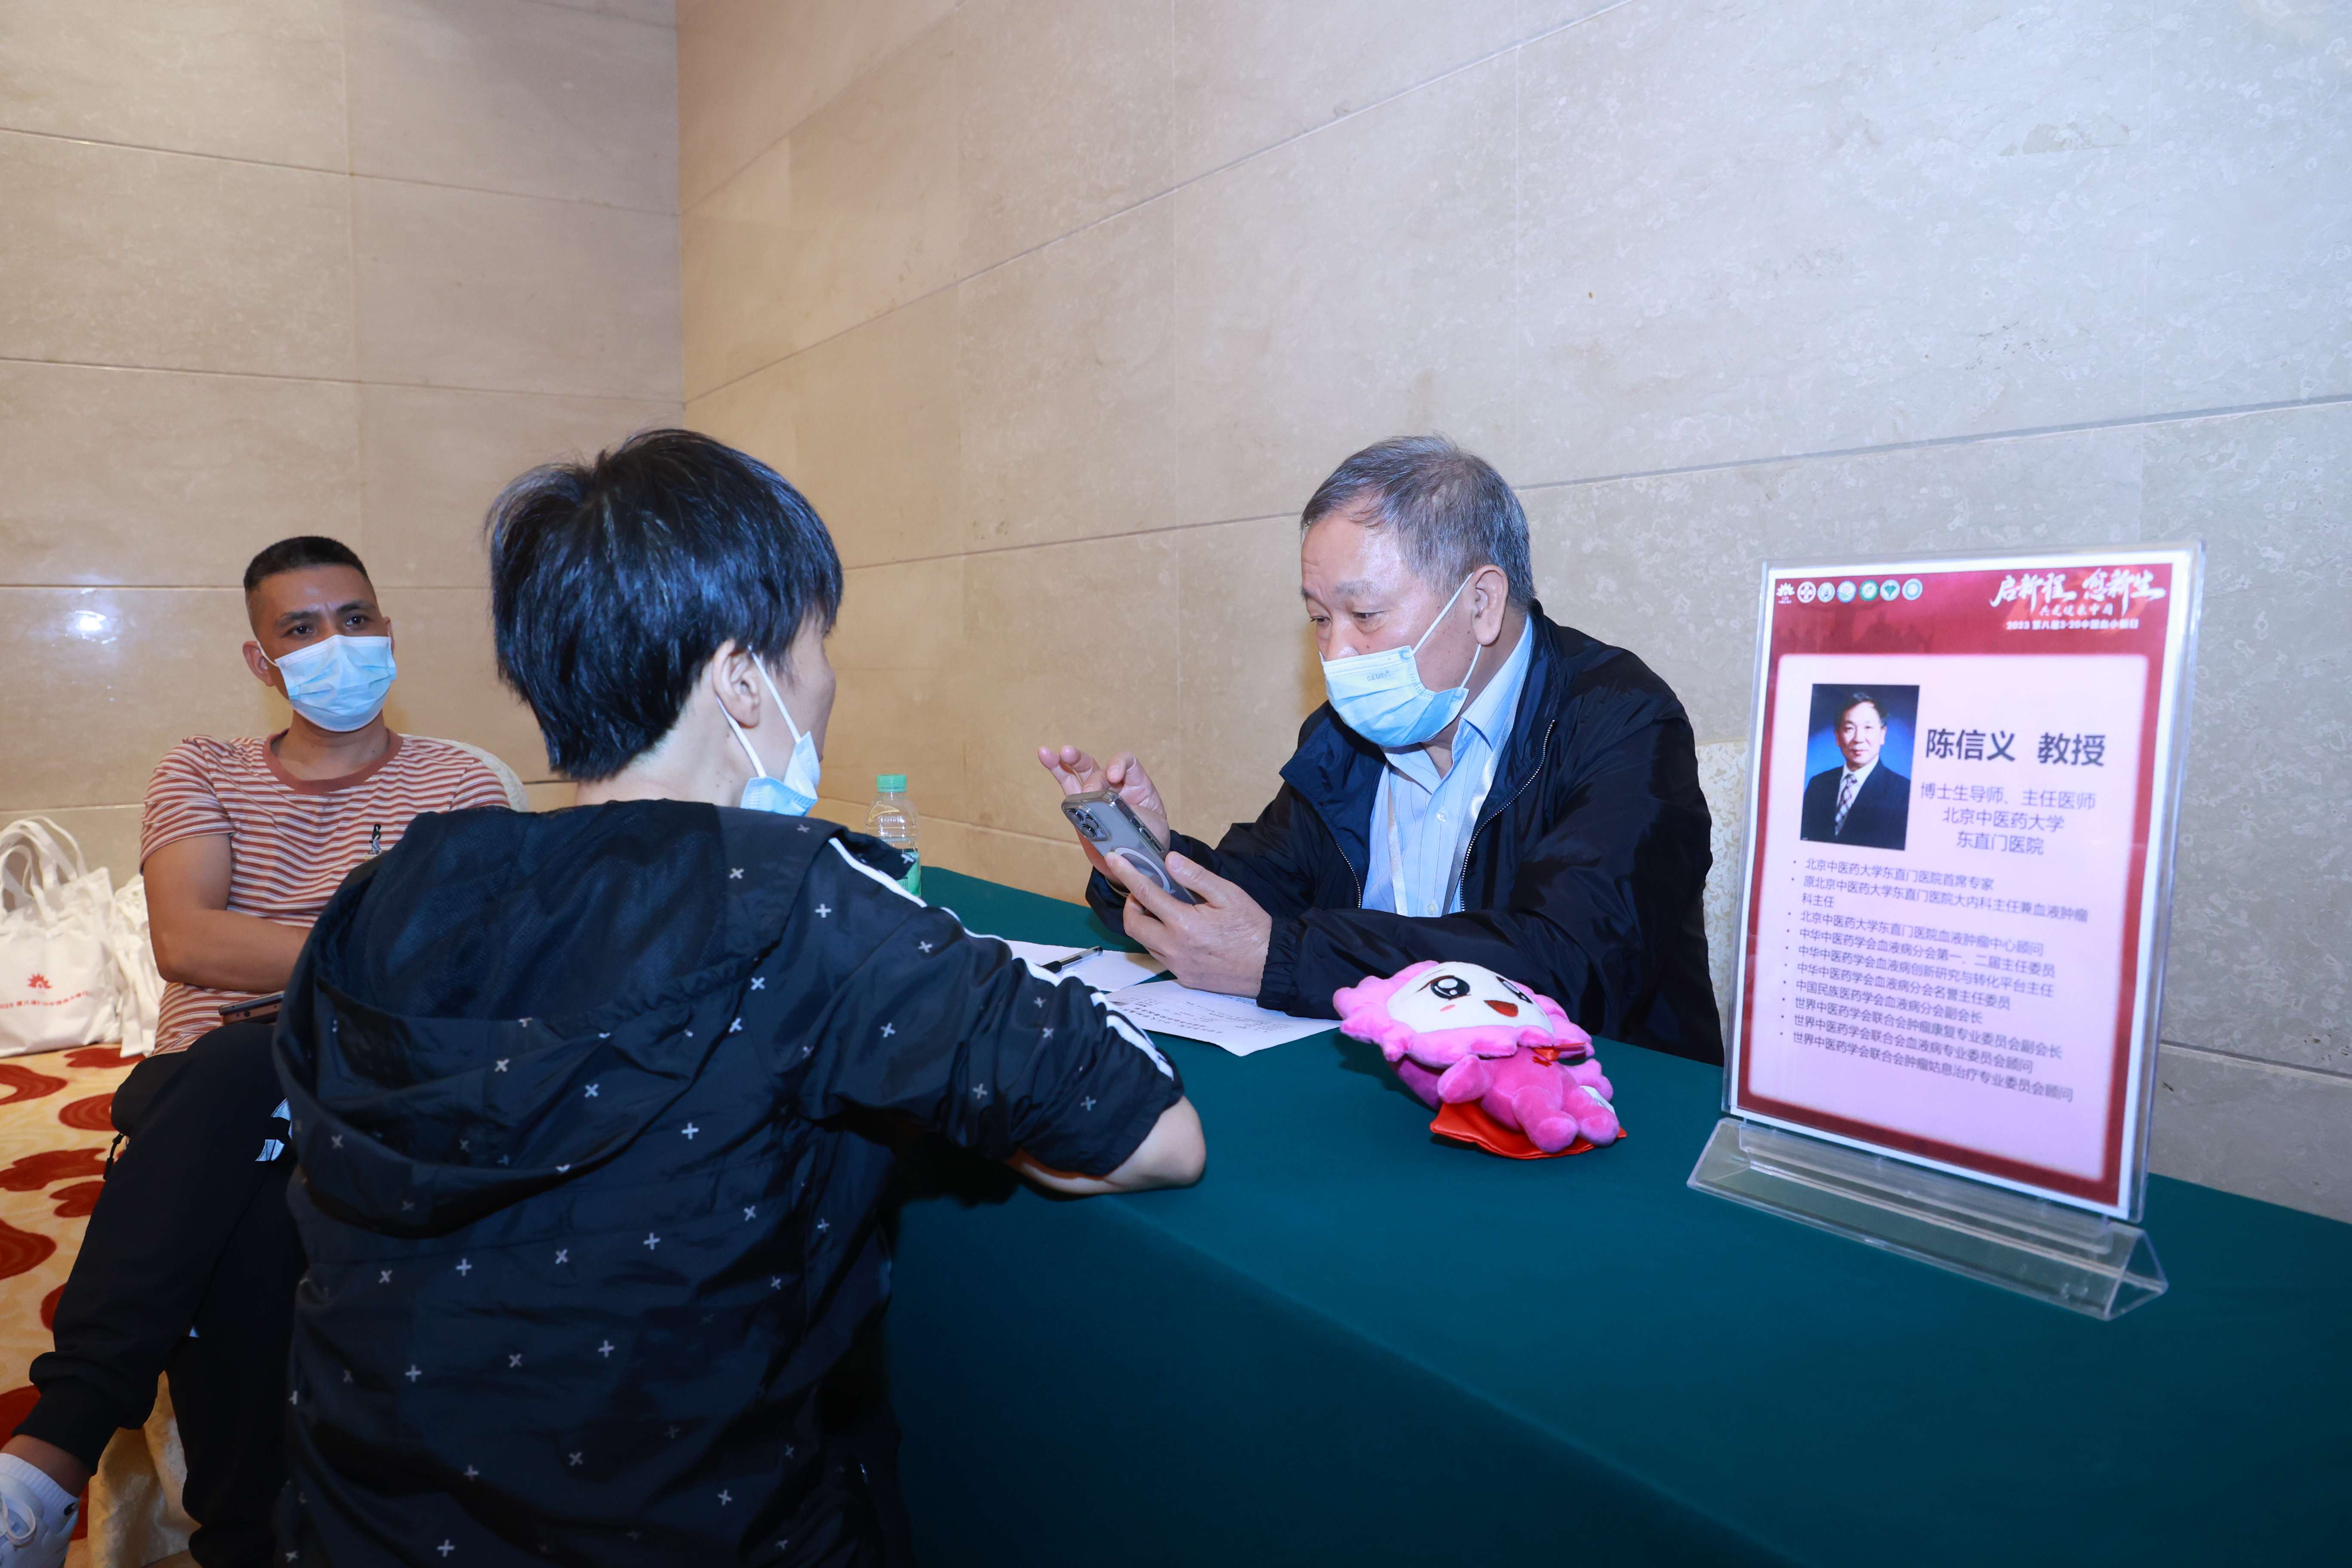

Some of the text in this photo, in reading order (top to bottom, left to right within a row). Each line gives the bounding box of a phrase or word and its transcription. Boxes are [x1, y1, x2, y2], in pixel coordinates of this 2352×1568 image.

[1926, 728, 2106, 767] 陈信义 教授
[1942, 806, 2064, 833] 北京中医药大学
[1956, 830, 2045, 856] 东直门医院
[1805, 858, 1994, 891] 北京中医药大学东直门医院首席专家
[1802, 893, 1834, 908] 科主任
[1796, 979, 1983, 1024] 中国民族医药学会血液病分会副会长
